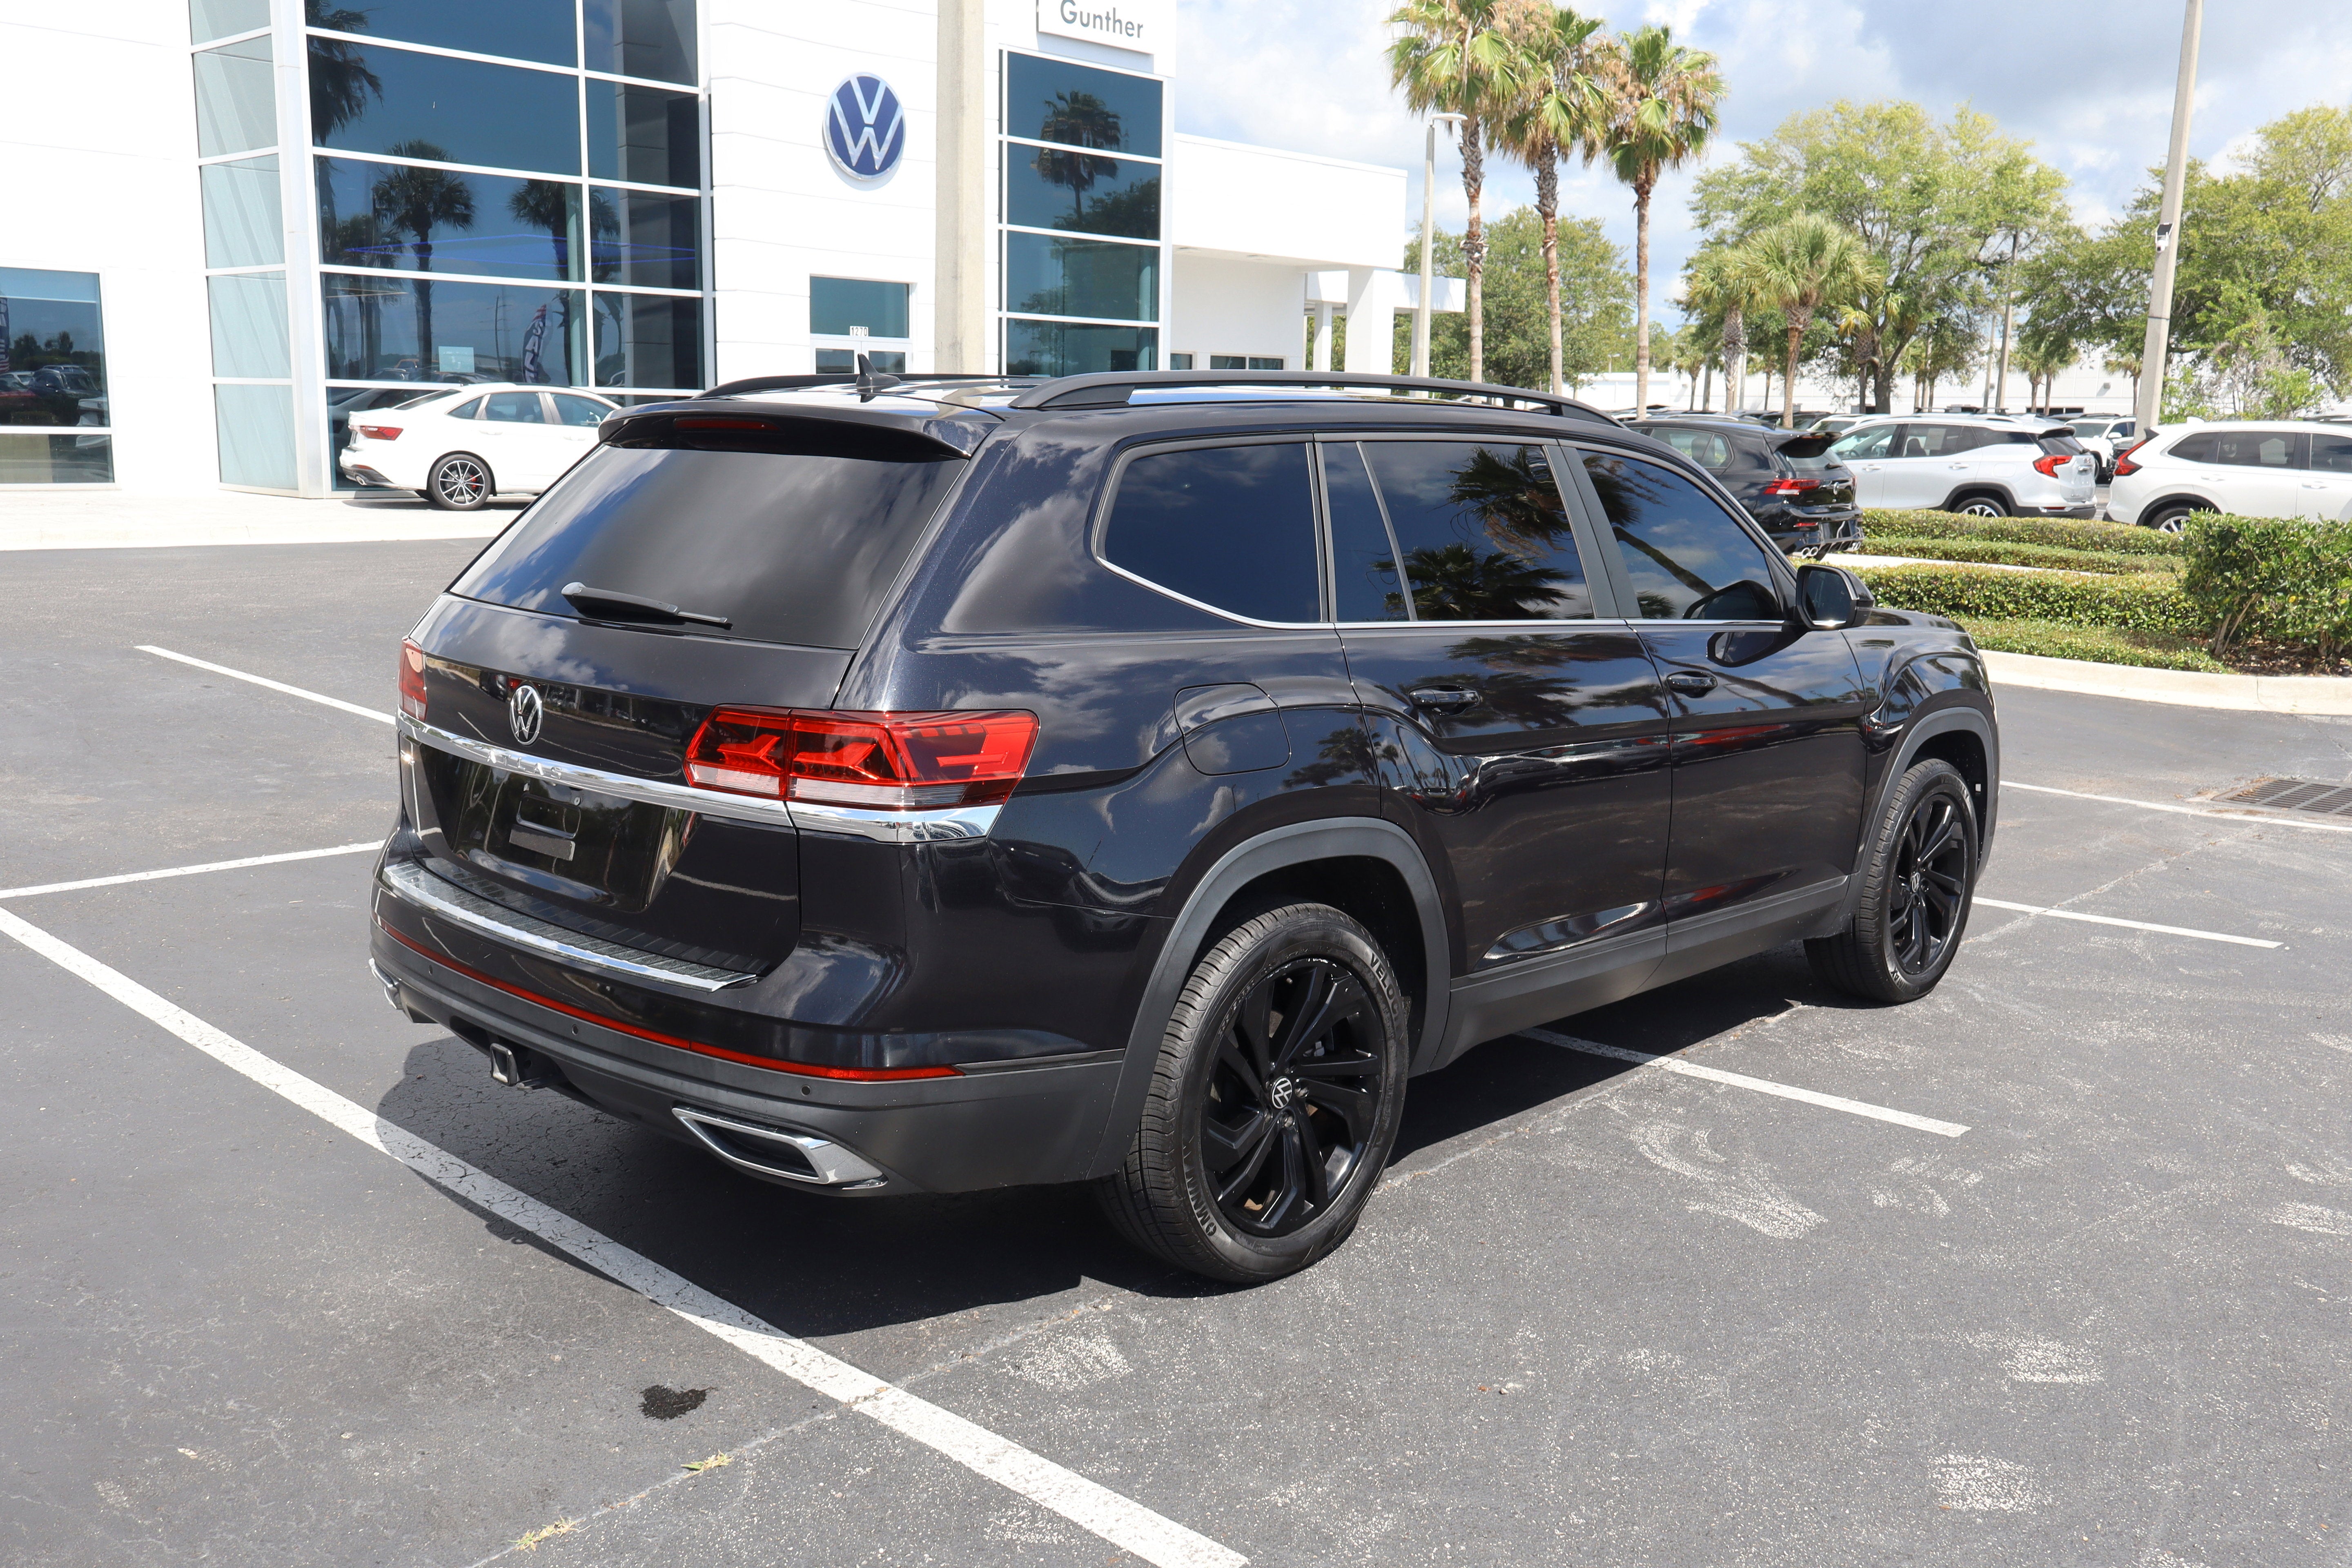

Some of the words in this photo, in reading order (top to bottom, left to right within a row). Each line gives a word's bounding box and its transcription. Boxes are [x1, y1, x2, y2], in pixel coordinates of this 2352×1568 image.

[1060, 0, 1143, 39] Gunther
[829, 74, 904, 172] VW
[851, 327, 868, 336] 1270
[512, 686, 541, 742] VW
[487, 749, 562, 780] ATLAS
[1370, 952, 1404, 1039] VELOC
[1273, 1079, 1292, 1108] VW
